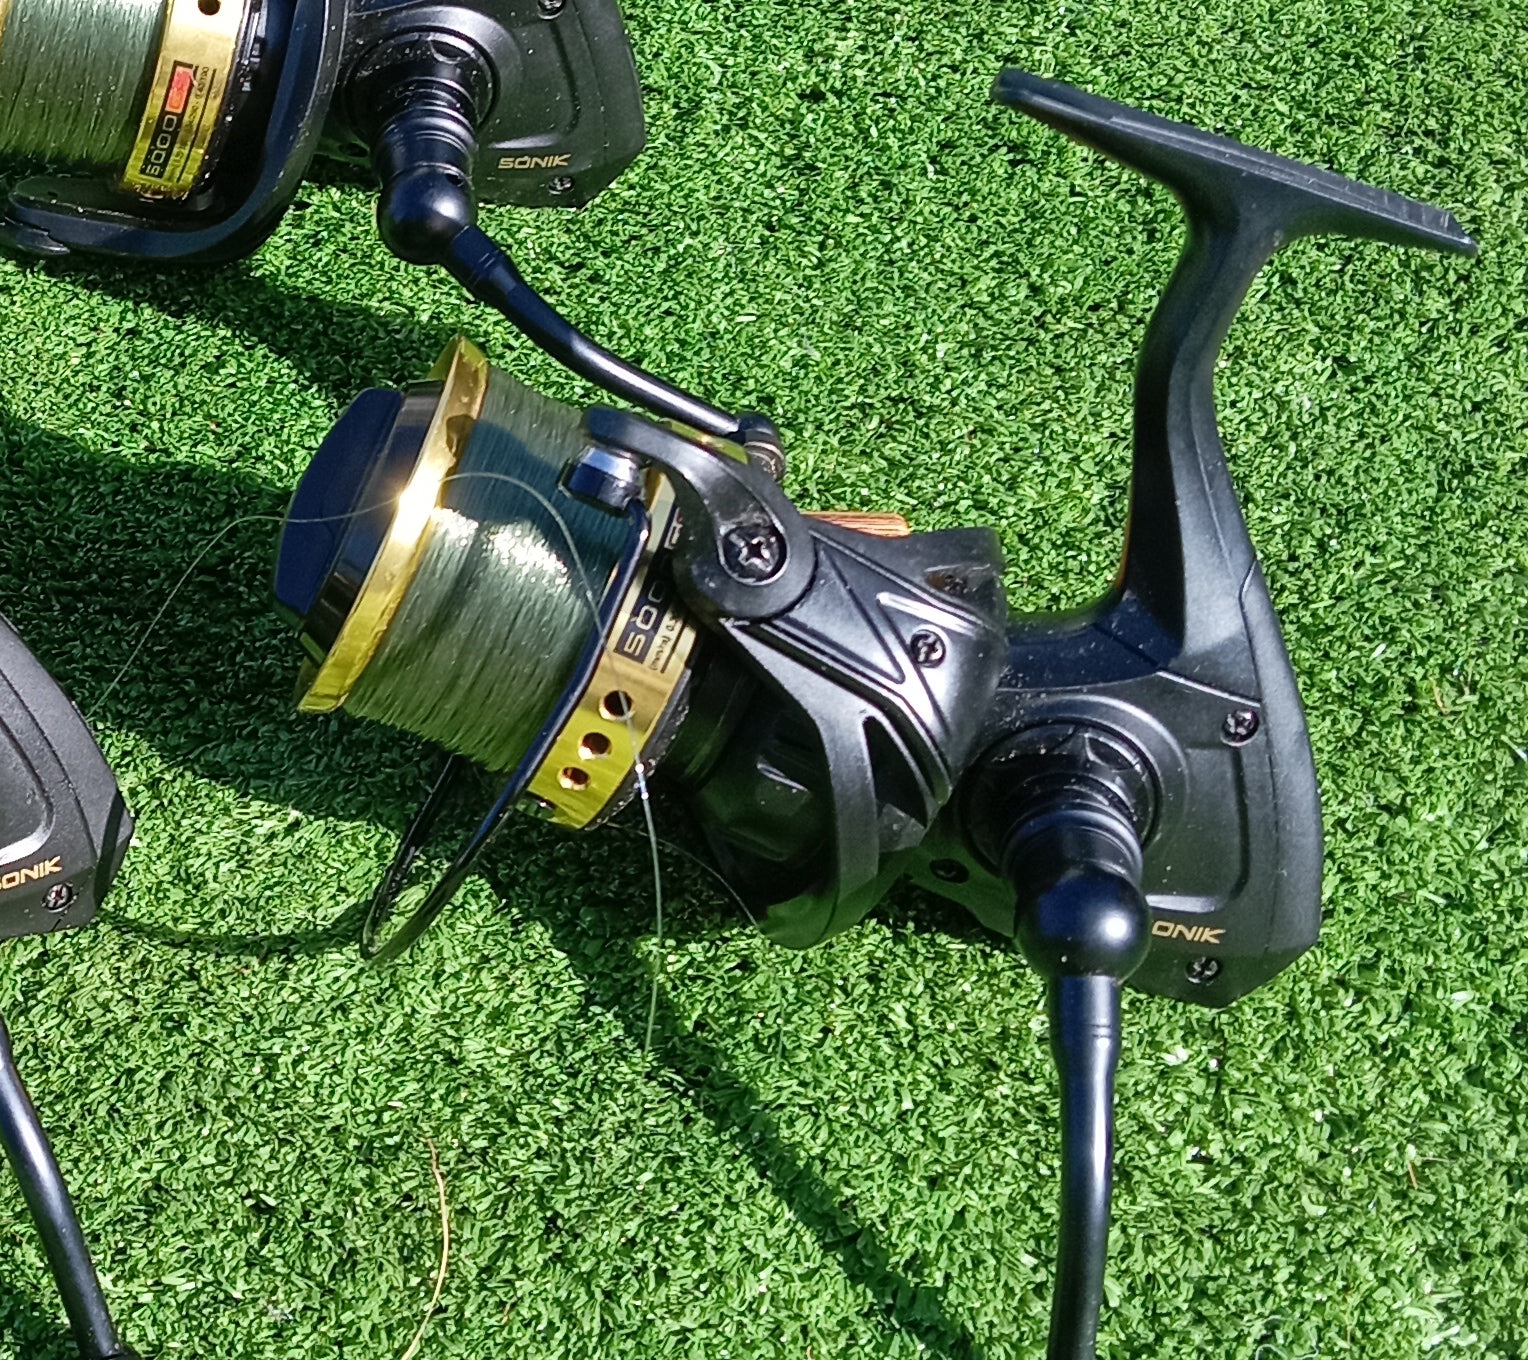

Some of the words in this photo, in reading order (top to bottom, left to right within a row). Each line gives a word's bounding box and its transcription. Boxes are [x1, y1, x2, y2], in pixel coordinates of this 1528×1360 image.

[145, 114, 178, 177] 5000
[498, 153, 571, 169] SONIK
[1151, 920, 1226, 944] ONIK
